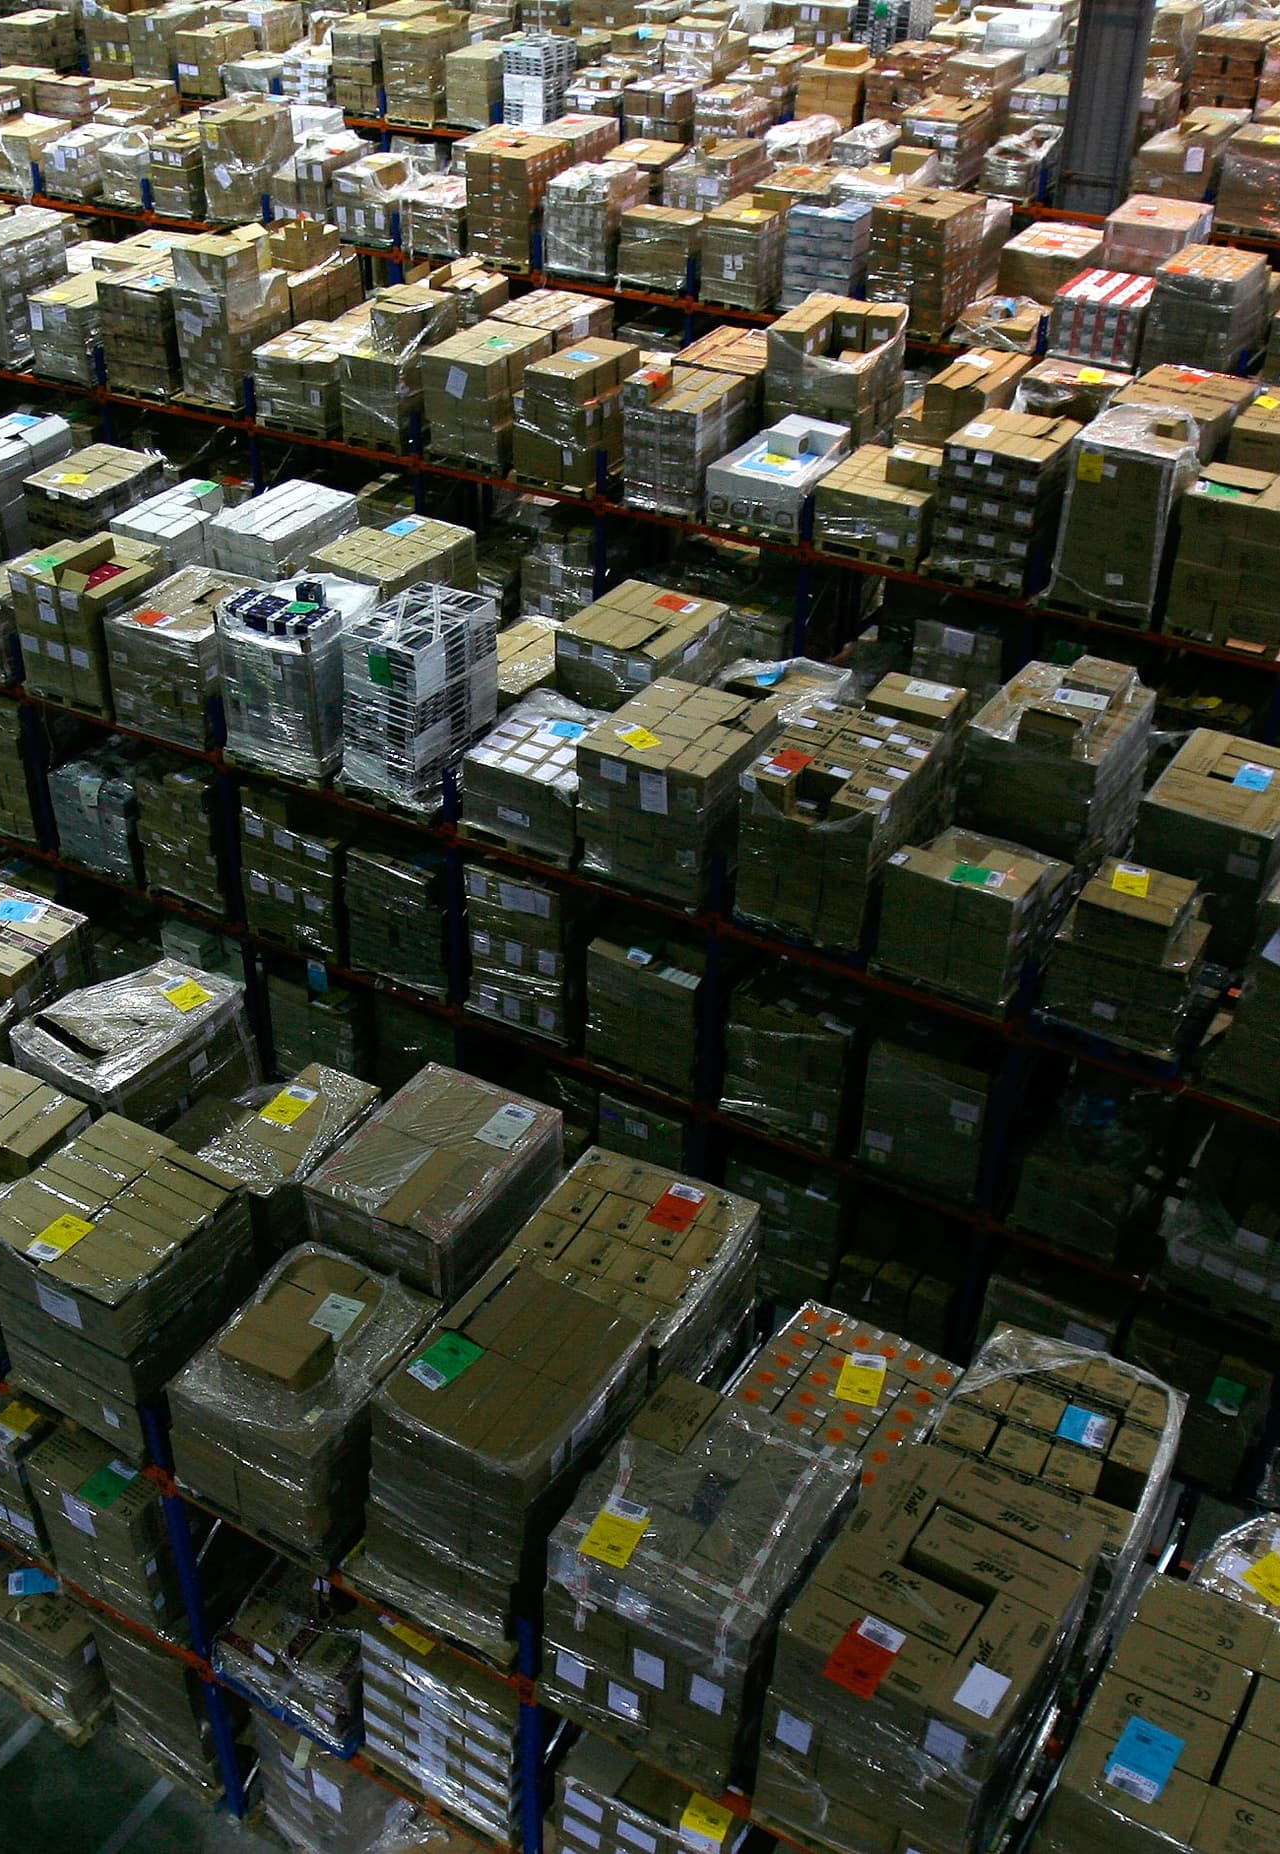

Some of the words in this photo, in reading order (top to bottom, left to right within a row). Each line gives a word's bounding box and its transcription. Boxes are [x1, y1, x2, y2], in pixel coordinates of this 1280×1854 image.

[997, 1510, 1040, 1532] Flair
[972, 1560, 1015, 1582] Flair
[1125, 1692, 1145, 1708] CE
[1235, 1809, 1256, 1825] CE
